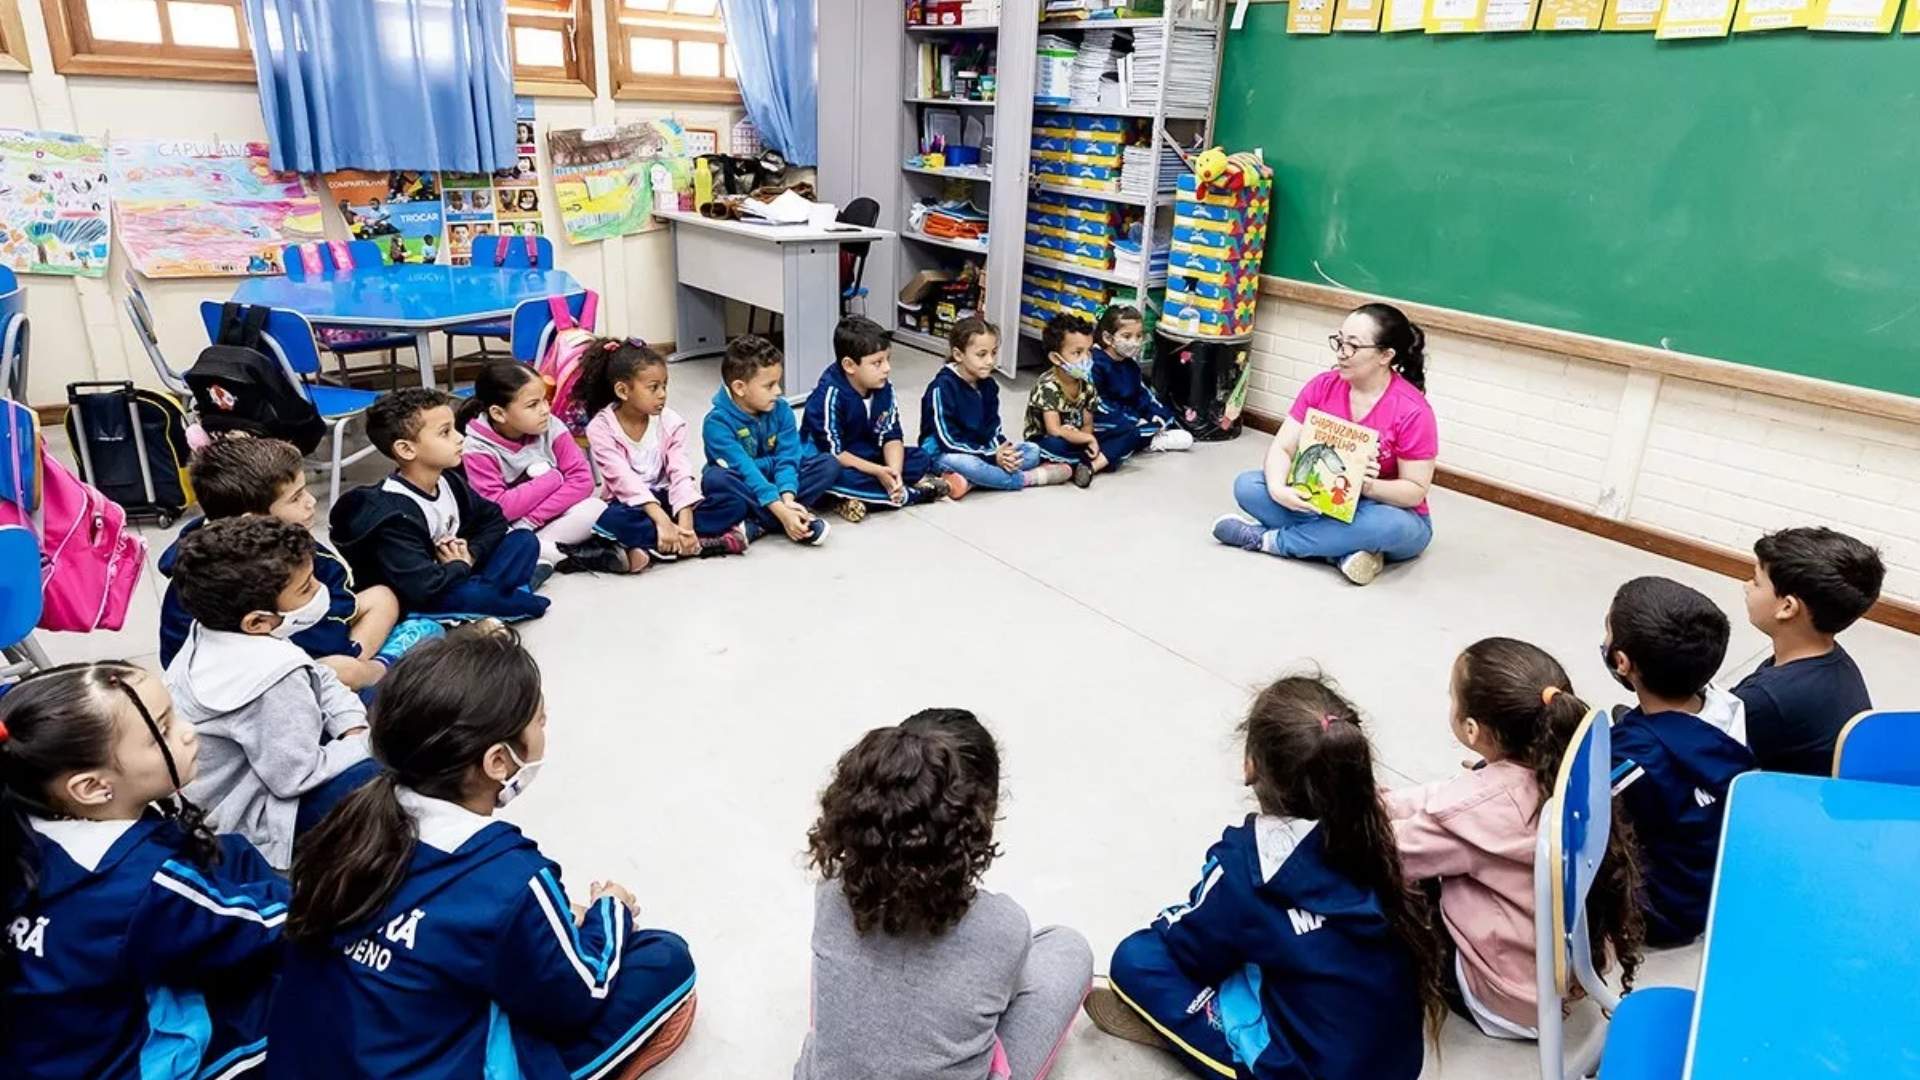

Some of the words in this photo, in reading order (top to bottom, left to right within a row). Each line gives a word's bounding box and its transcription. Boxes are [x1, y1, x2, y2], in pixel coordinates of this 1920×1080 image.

[400, 212, 439, 225] TROCAR
[1311, 414, 1370, 443] CHAPEUZINHO
[8, 915, 51, 958] RÃ
[378, 908, 426, 950] RÃ
